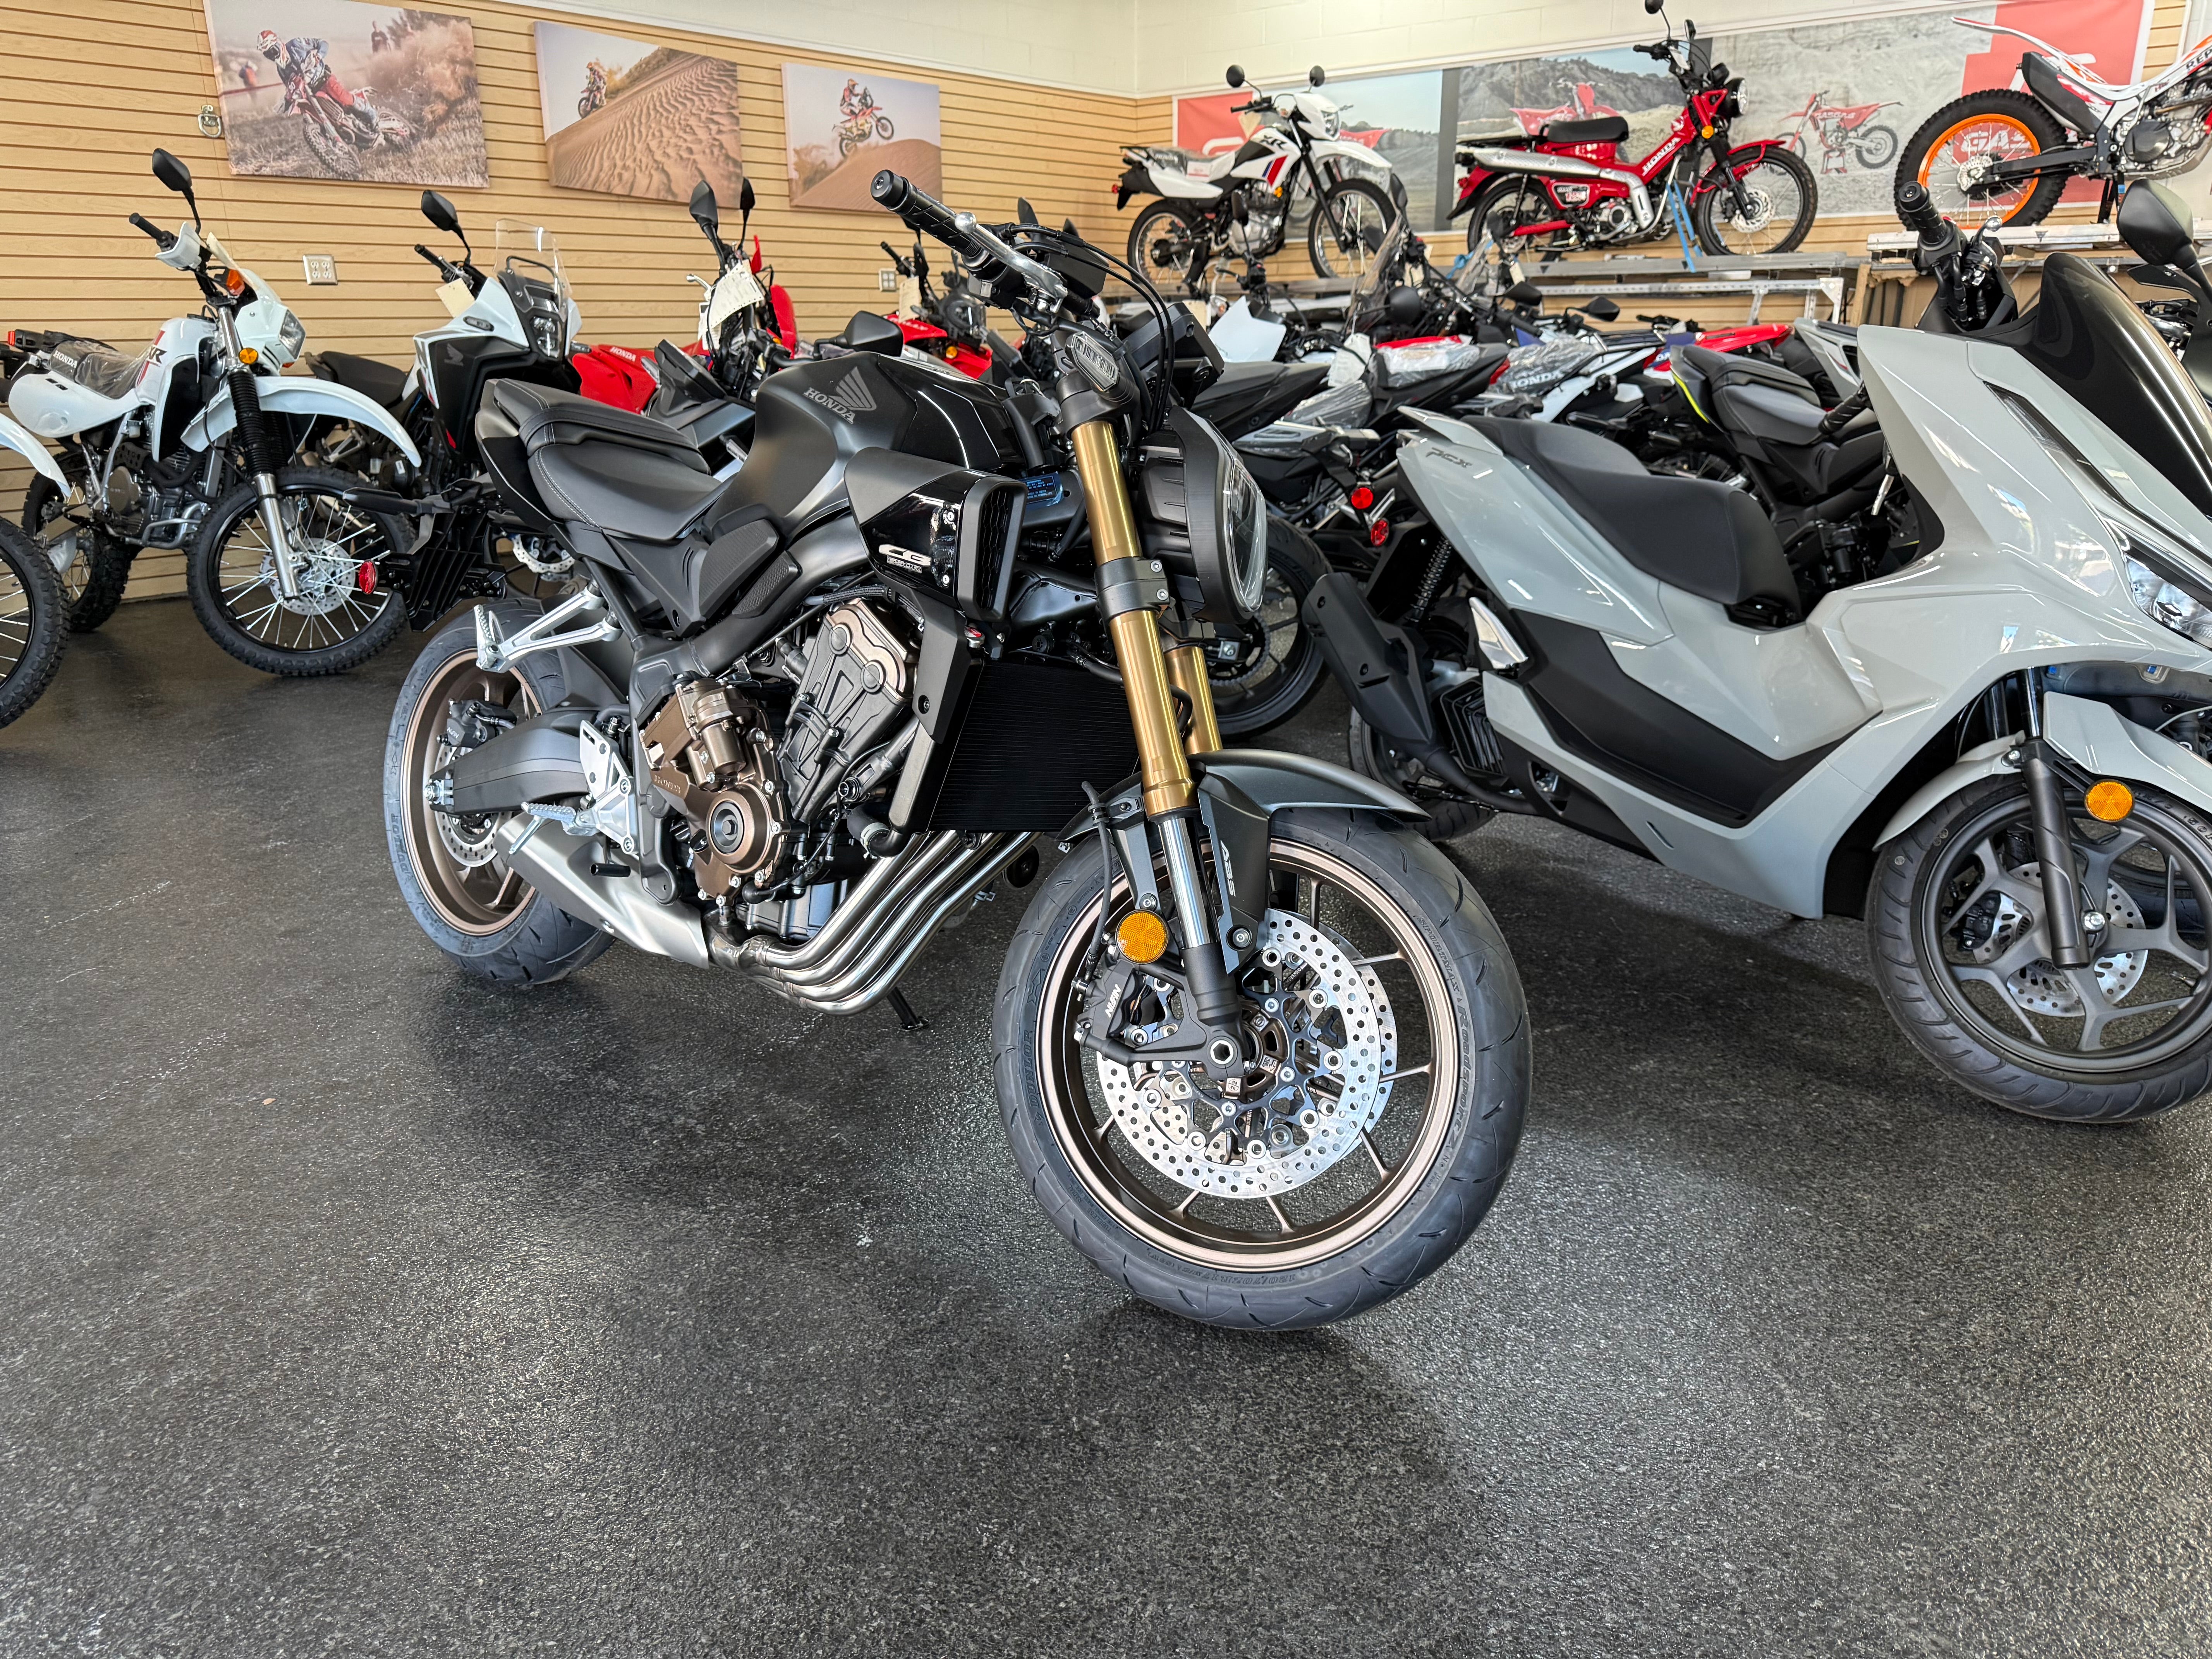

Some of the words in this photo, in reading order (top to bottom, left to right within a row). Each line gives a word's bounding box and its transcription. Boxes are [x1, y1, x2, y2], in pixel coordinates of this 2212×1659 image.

[1259, 135, 1287, 151] XR
[1642, 137, 1681, 177] HONDA
[53, 350, 78, 368] HONDA
[610, 346, 636, 362] HONDA
[803, 386, 855, 424] HONDA
[1425, 447, 1473, 468] PCX
[879, 544, 932, 566] CB
[1221, 841, 1236, 897] ABS
[1417, 916, 1460, 993] SPORTMAX
[1022, 1030, 1039, 1109] DUNLOP
[1068, 1185, 1083, 1203] RADIAL
[1087, 1208, 1112, 1233] TUBELESS
